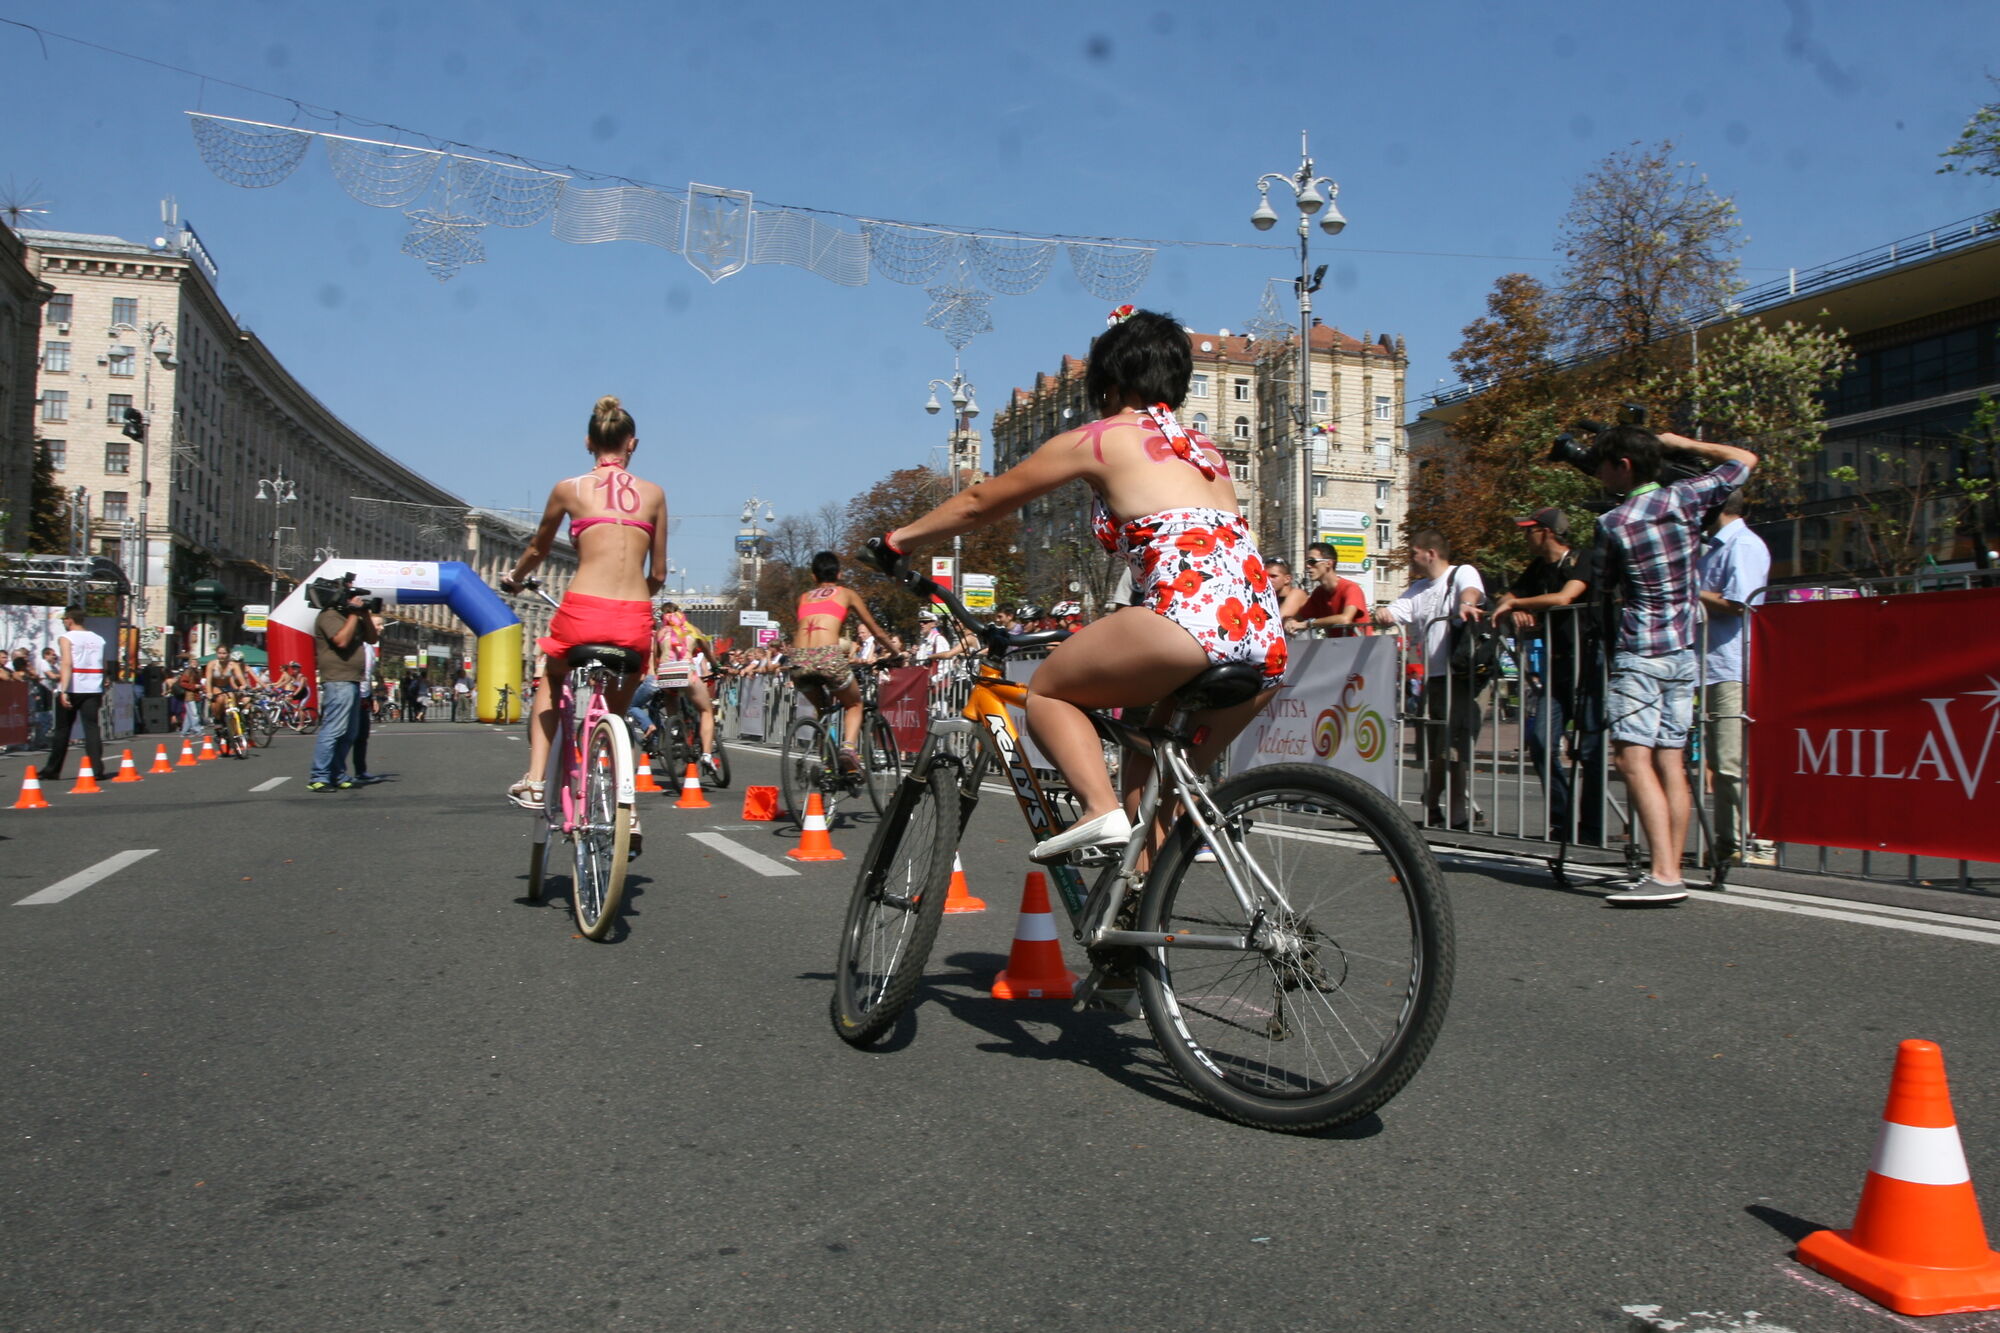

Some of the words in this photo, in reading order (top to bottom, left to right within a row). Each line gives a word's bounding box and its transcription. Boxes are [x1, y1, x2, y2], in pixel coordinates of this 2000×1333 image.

[594, 471, 641, 514] 18
[1256, 699, 1308, 720] AVITSA
[1793, 698, 2000, 800] MILAV
